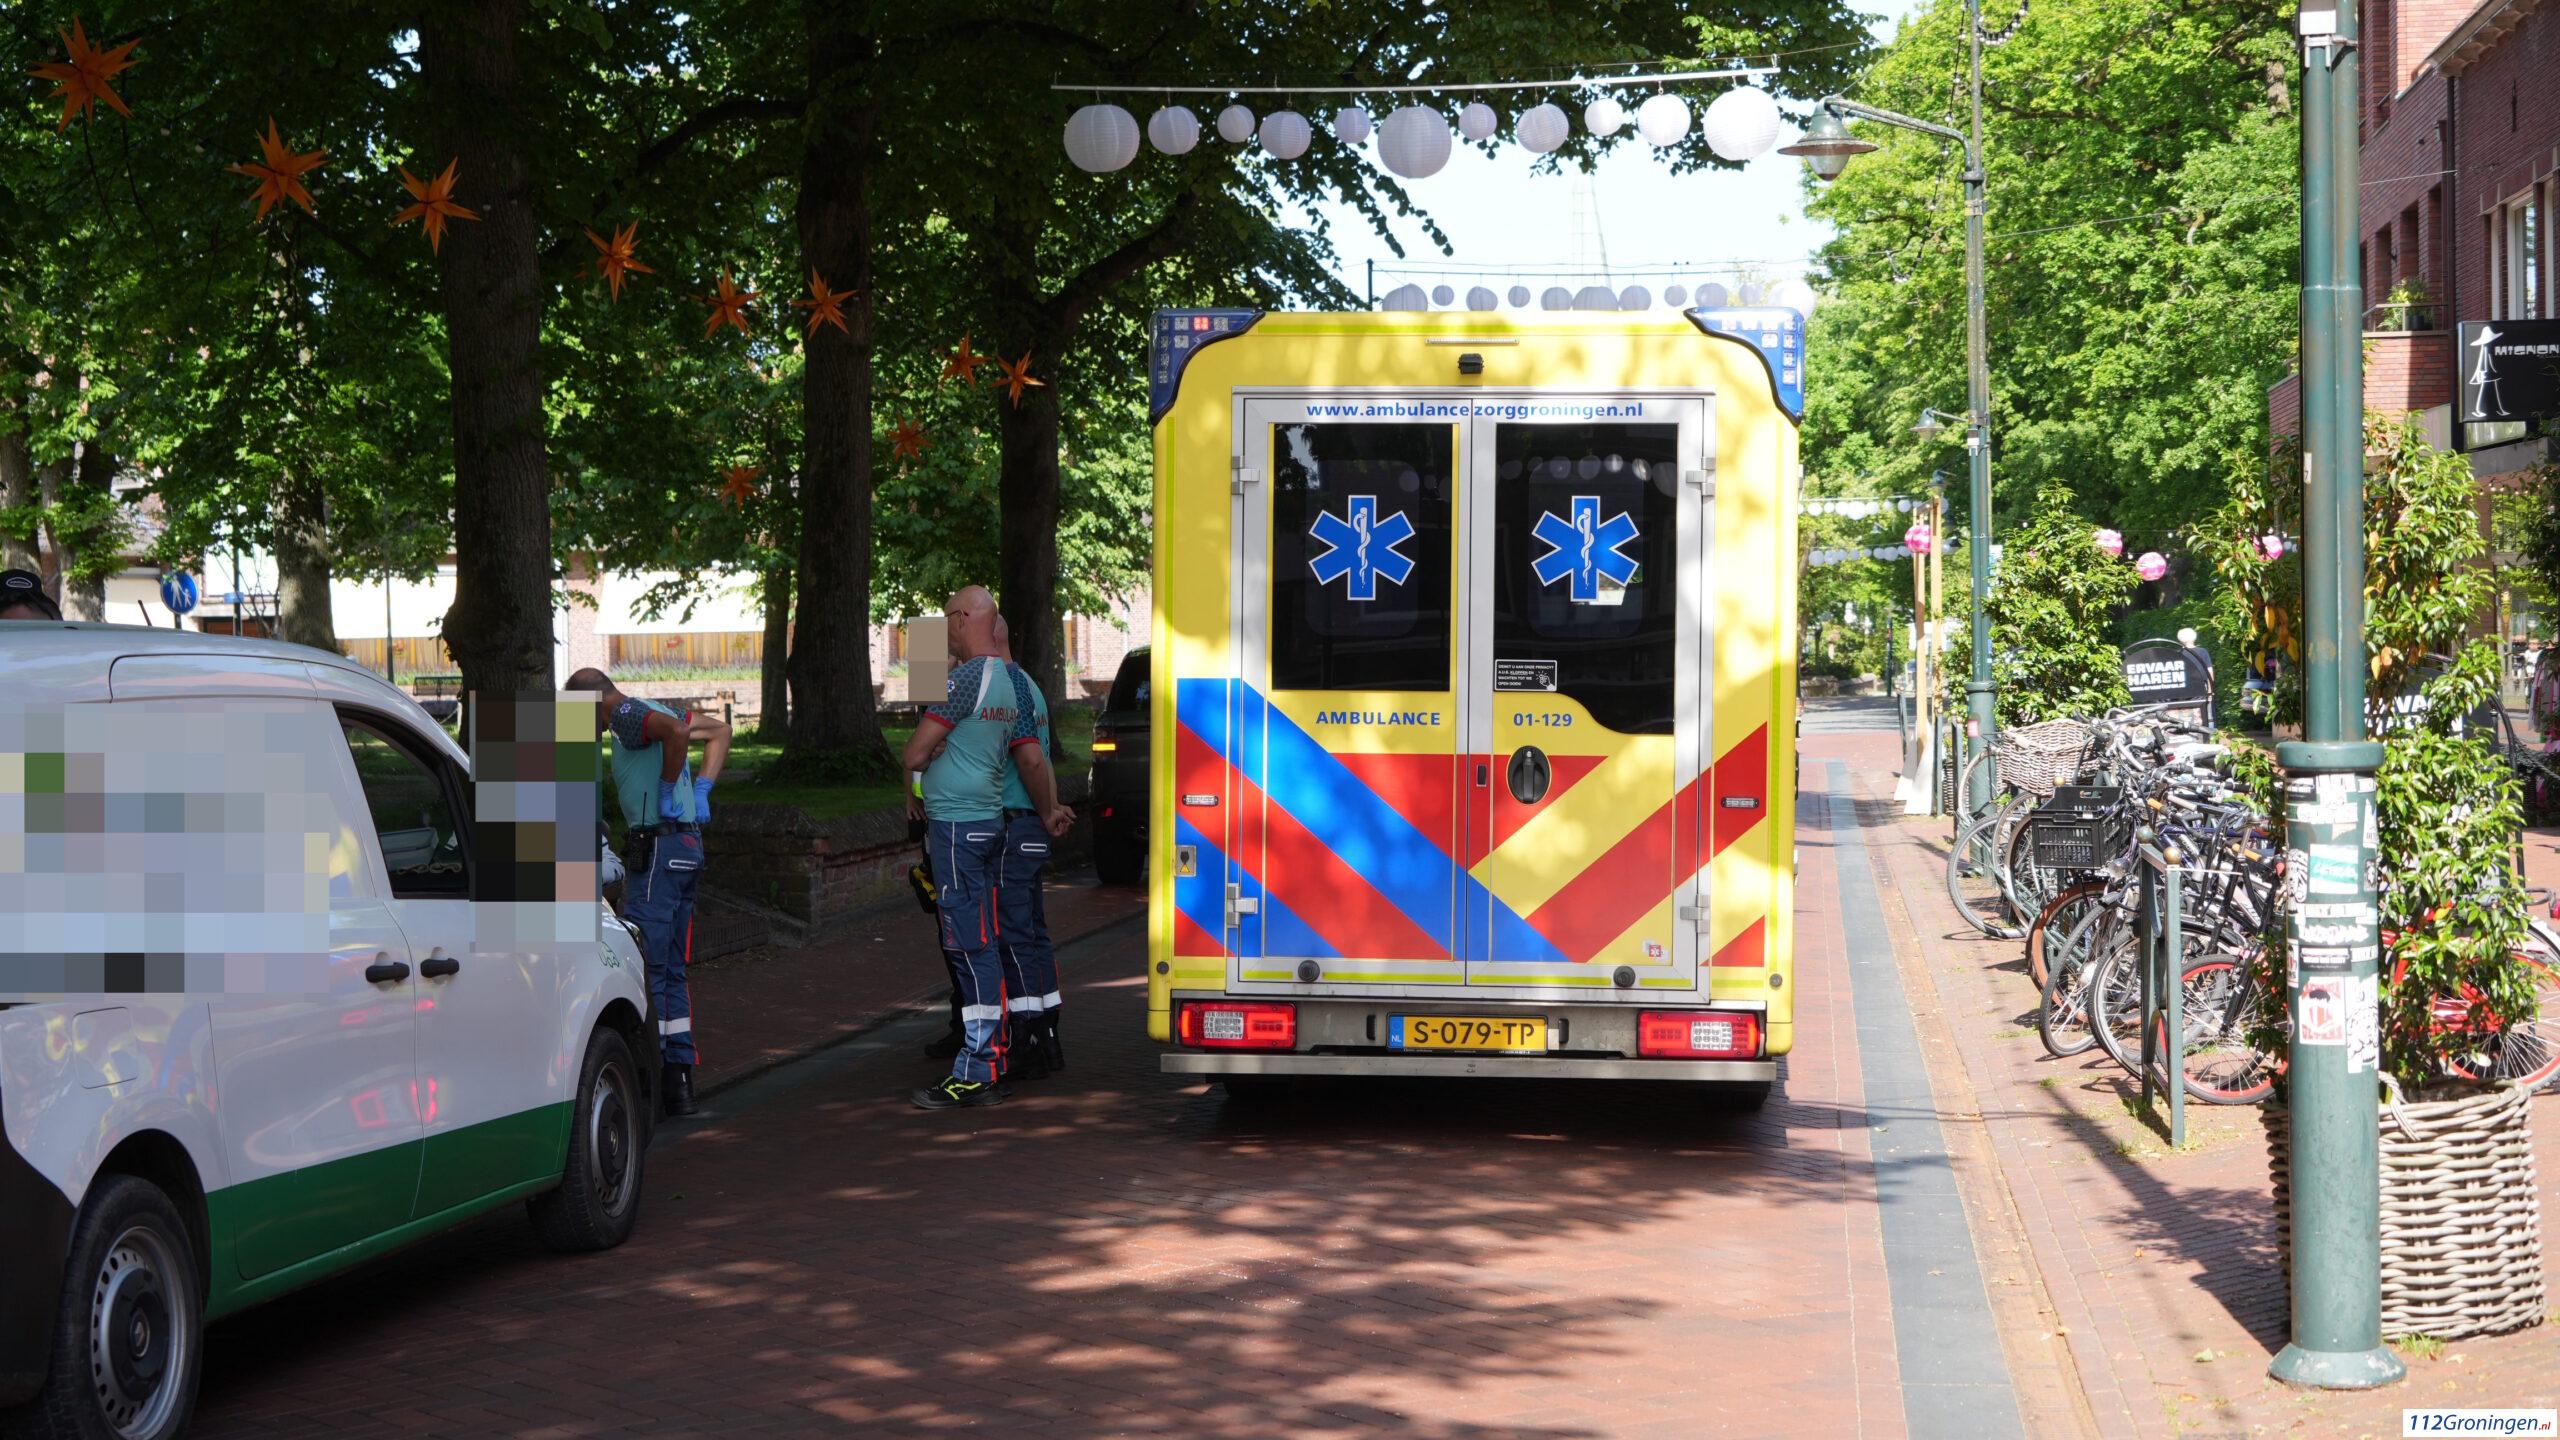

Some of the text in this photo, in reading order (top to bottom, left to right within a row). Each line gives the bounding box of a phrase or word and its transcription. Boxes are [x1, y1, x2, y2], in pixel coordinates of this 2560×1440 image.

[2126, 660, 2185, 675] ERVAAR
[2127, 671, 2186, 687] HAREN
[1316, 711, 1441, 726] AMBULANCE
[1513, 713, 1572, 727] 01-129
[1391, 1034, 1402, 1043] NL
[1413, 1020, 1535, 1046] S-079-TP
